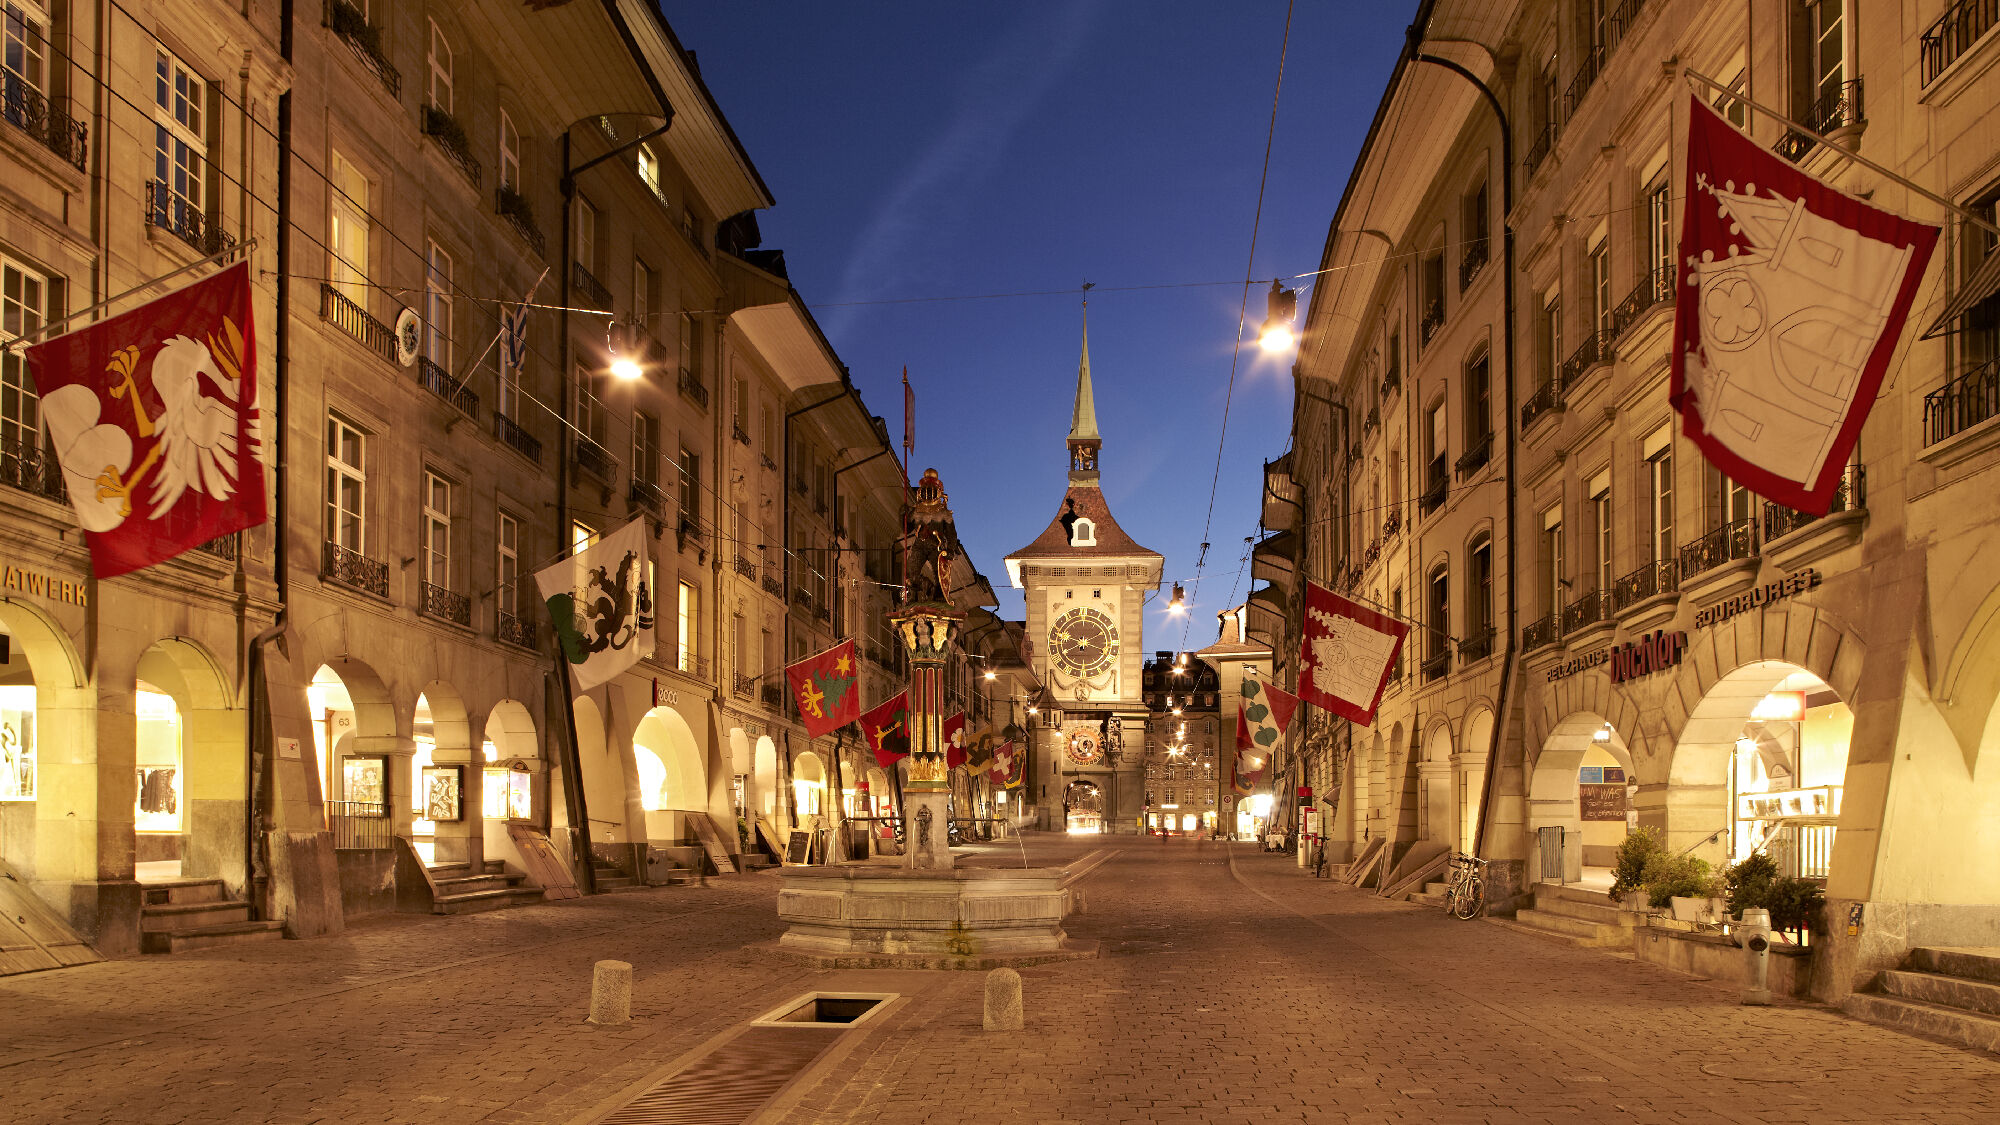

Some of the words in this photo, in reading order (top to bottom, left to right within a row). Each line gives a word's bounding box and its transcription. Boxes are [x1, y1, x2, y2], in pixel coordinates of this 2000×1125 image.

[0, 565, 88, 608] ATWERK
[1695, 567, 1815, 630] FOURRURES
[1547, 649, 1608, 682] PELZHAUS
[658, 687, 678, 705] ecco
[338, 718, 350, 726] 63
